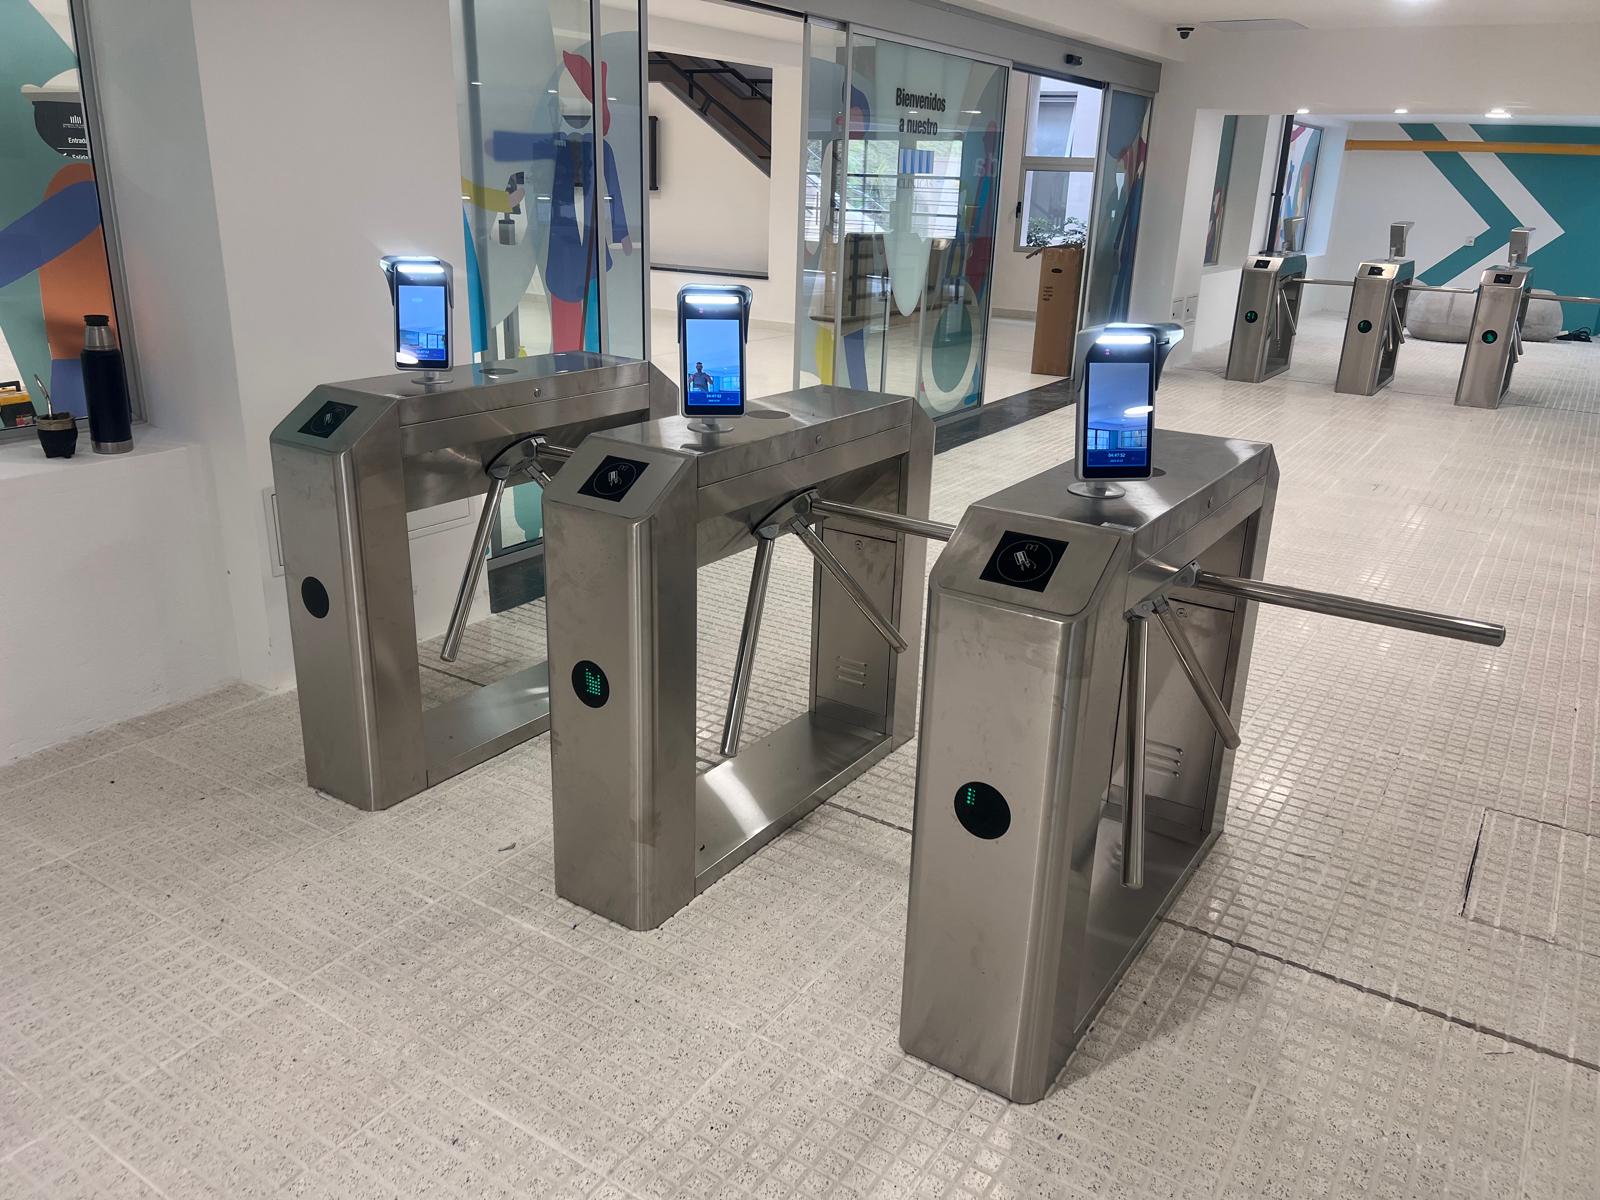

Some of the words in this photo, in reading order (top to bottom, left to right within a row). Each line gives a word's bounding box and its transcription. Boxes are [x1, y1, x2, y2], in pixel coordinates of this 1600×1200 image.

[896, 88, 946, 112] Bienvenidos
[899, 118, 905, 133] a
[906, 117, 938, 136] nuestro
